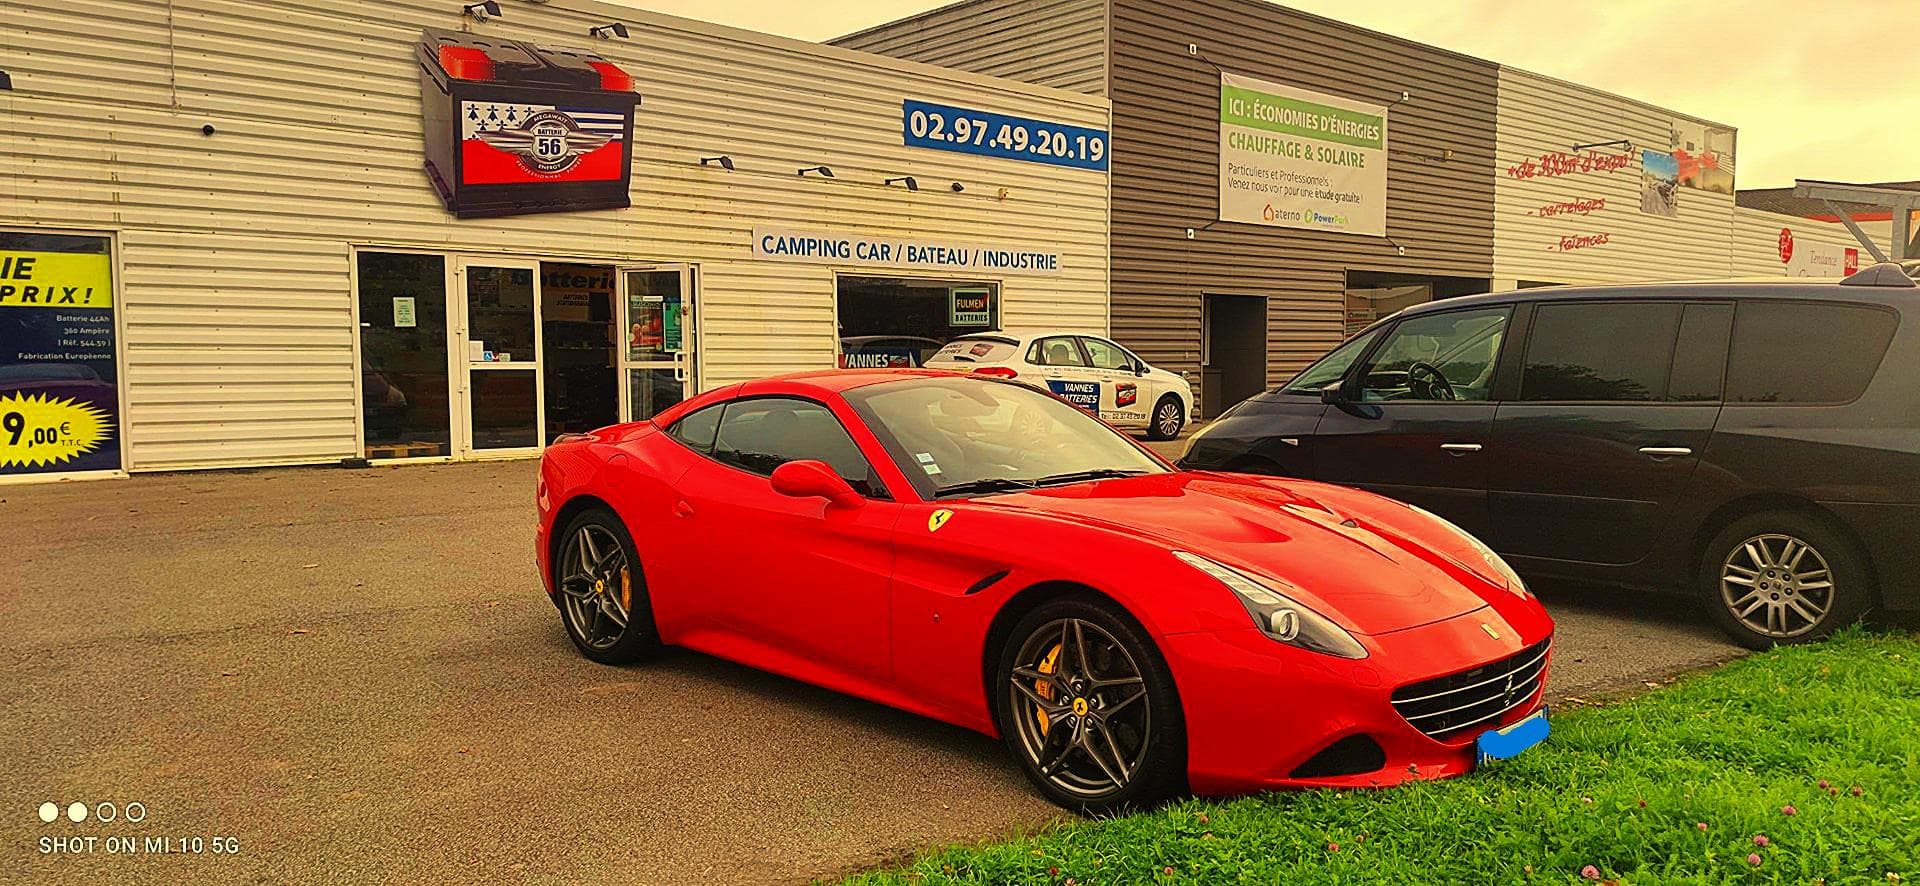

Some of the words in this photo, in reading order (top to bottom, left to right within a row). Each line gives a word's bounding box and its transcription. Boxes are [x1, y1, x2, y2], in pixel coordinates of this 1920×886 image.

[533, 113, 568, 123] MEGAWATT
[1229, 98, 1244, 117] ICI
[1253, 98, 1318, 131] ÉCONOMIES
[1321, 115, 1380, 141] D'ÉNERGIES
[910, 110, 1104, 162] 02.97.49.20.19
[538, 138, 561, 155] 56
[1229, 132, 1301, 159] CHAUFFAGE
[1304, 144, 1314, 161] &
[1317, 146, 1365, 168] SOLAIRE
[1228, 162, 1269, 179] Particuliers
[1270, 170, 1278, 180] et
[1280, 170, 1329, 187] Professionnels
[1228, 177, 1249, 190] Venez
[1251, 181, 1268, 192] nous
[1270, 183, 1282, 194] voir
[1284, 186, 1299, 198] pour
[1301, 188, 1313, 198] une
[1334, 191, 1360, 204] gratuite
[1275, 208, 1301, 221] aterno
[761, 234, 850, 259] CAMPING
[855, 241, 891, 262] CAR
[907, 245, 968, 266] BATEAU
[983, 250, 1057, 270] INDUSTRIE
[956, 298, 984, 310] FULMEN
[56, 314, 88, 322] Batterie
[955, 313, 988, 322] BATTERIES
[18, 352, 63, 360] Fabrication
[1064, 383, 1094, 392] VANNES
